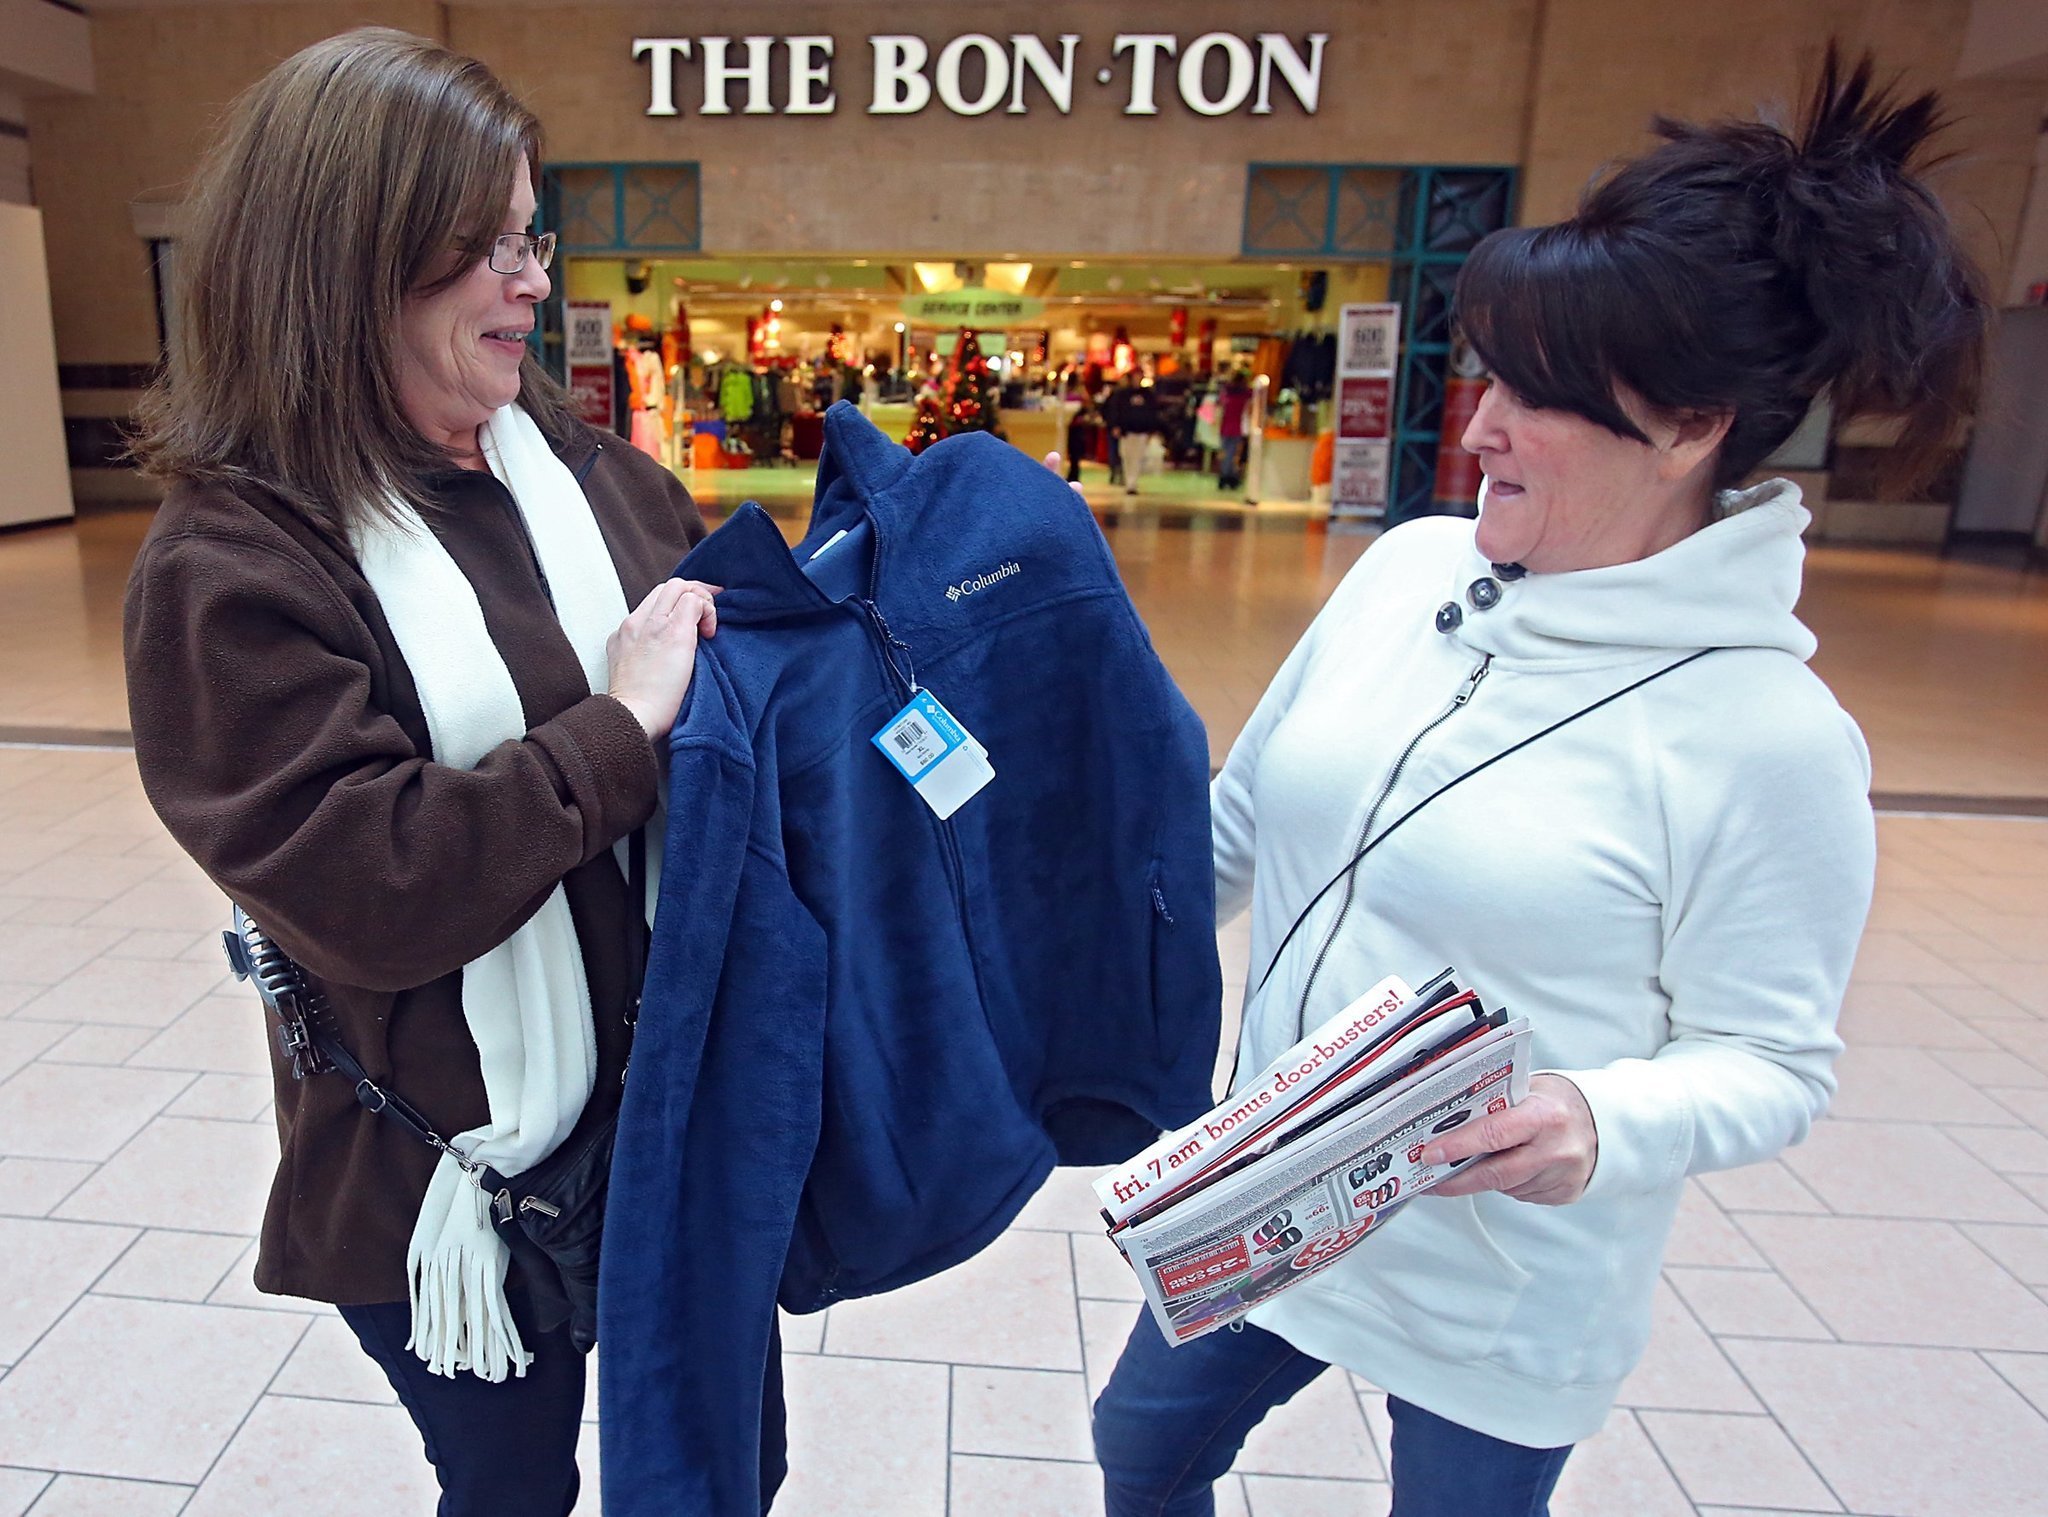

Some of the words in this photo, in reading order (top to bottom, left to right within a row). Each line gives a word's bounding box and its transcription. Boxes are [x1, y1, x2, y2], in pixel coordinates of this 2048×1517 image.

[632, 36, 837, 117] THE
[960, 561, 1021, 595] Columbia
[934, 710, 961, 742] Columbia
[1112, 1173, 1150, 1204] fri.
[1146, 1159, 1163, 1180] 7
[1168, 1138, 1204, 1168] am
[1203, 1091, 1272, 1141] bonus
[1274, 989, 1405, 1095] doorbusters!
[1414, 1104, 1448, 1127] PRICE
[1372, 1123, 1414, 1151] MATCH
[1320, 1148, 1372, 1181] PROMISE
[1307, 1232, 1357, 1263] SAVE
